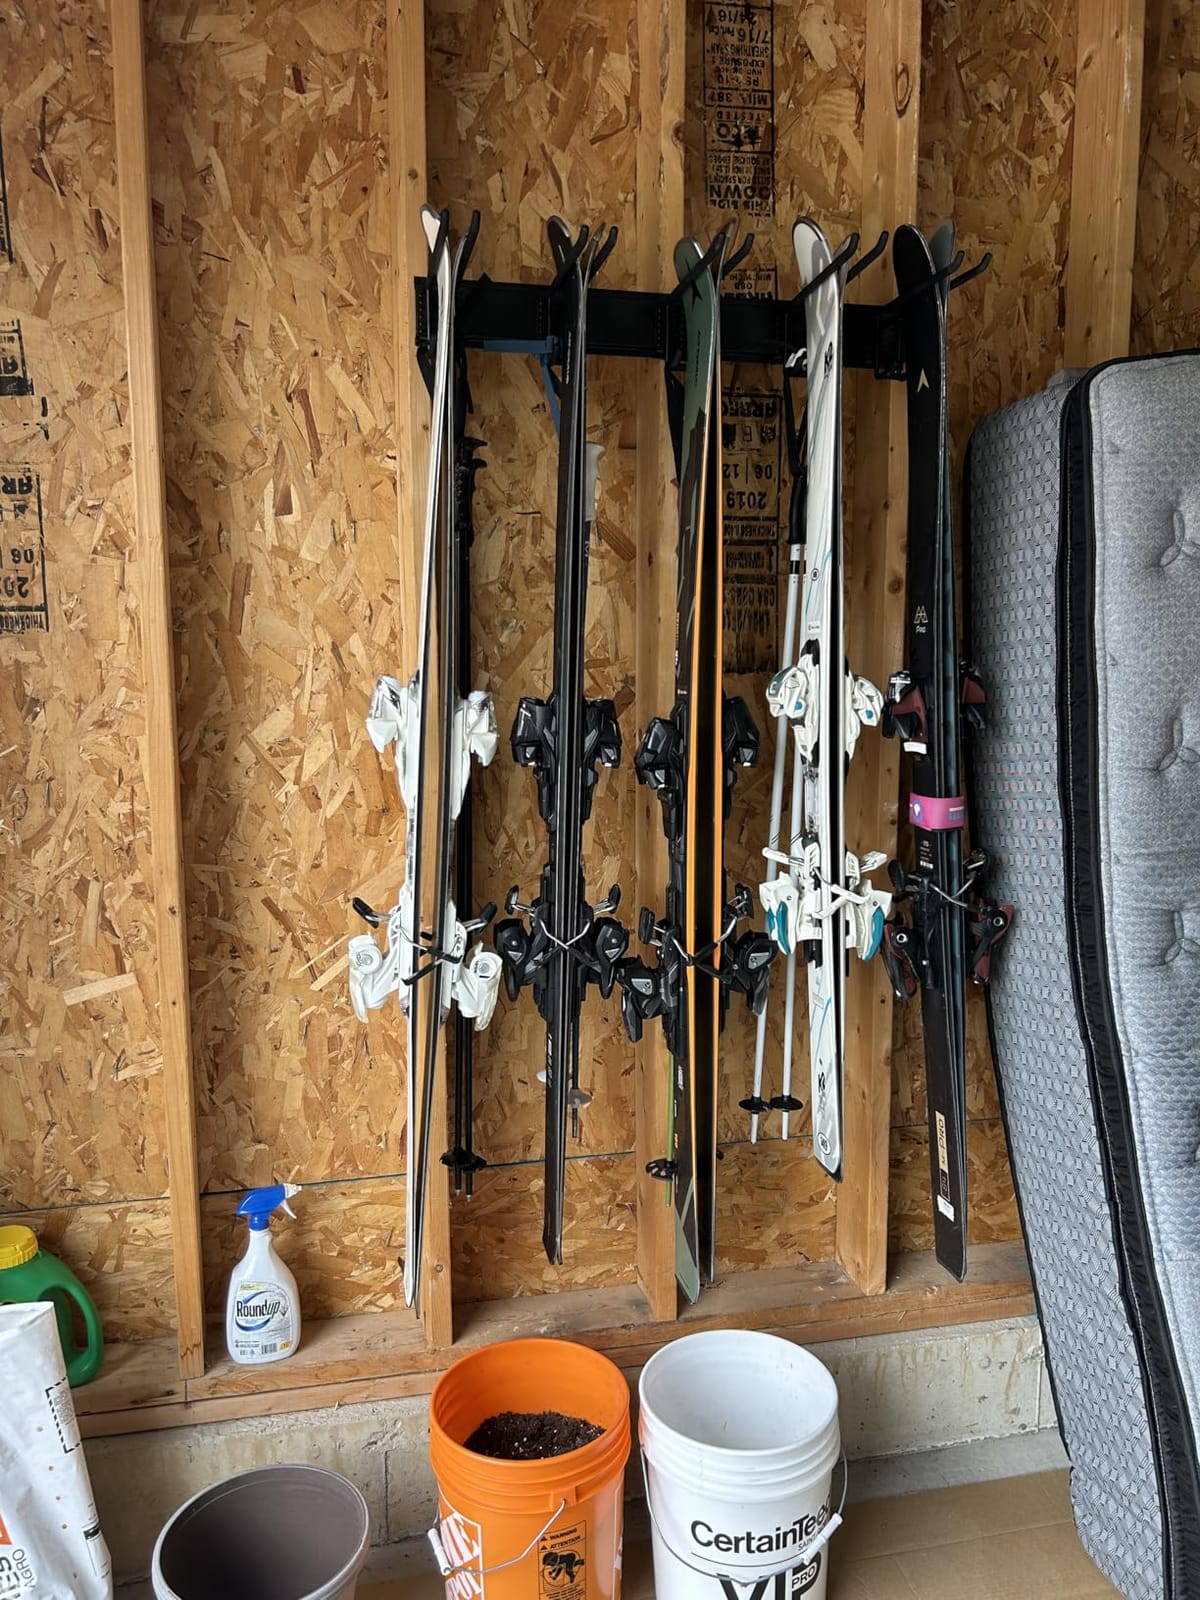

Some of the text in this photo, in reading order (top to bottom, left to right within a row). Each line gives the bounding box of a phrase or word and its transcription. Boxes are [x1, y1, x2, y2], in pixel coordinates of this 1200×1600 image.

[737, 28, 770, 44] 7/16
[716, 111, 761, 121] TESTED
[709, 185, 770, 199] DOWN
[734, 282, 753, 290] OSB
[722, 463, 773, 479] 06 12
[726, 491, 768, 510] 2019
[236, 1299, 281, 1320] Roundup
[550, 1535, 581, 1549] ATTENTION
[791, 1565, 816, 1589] PRO
